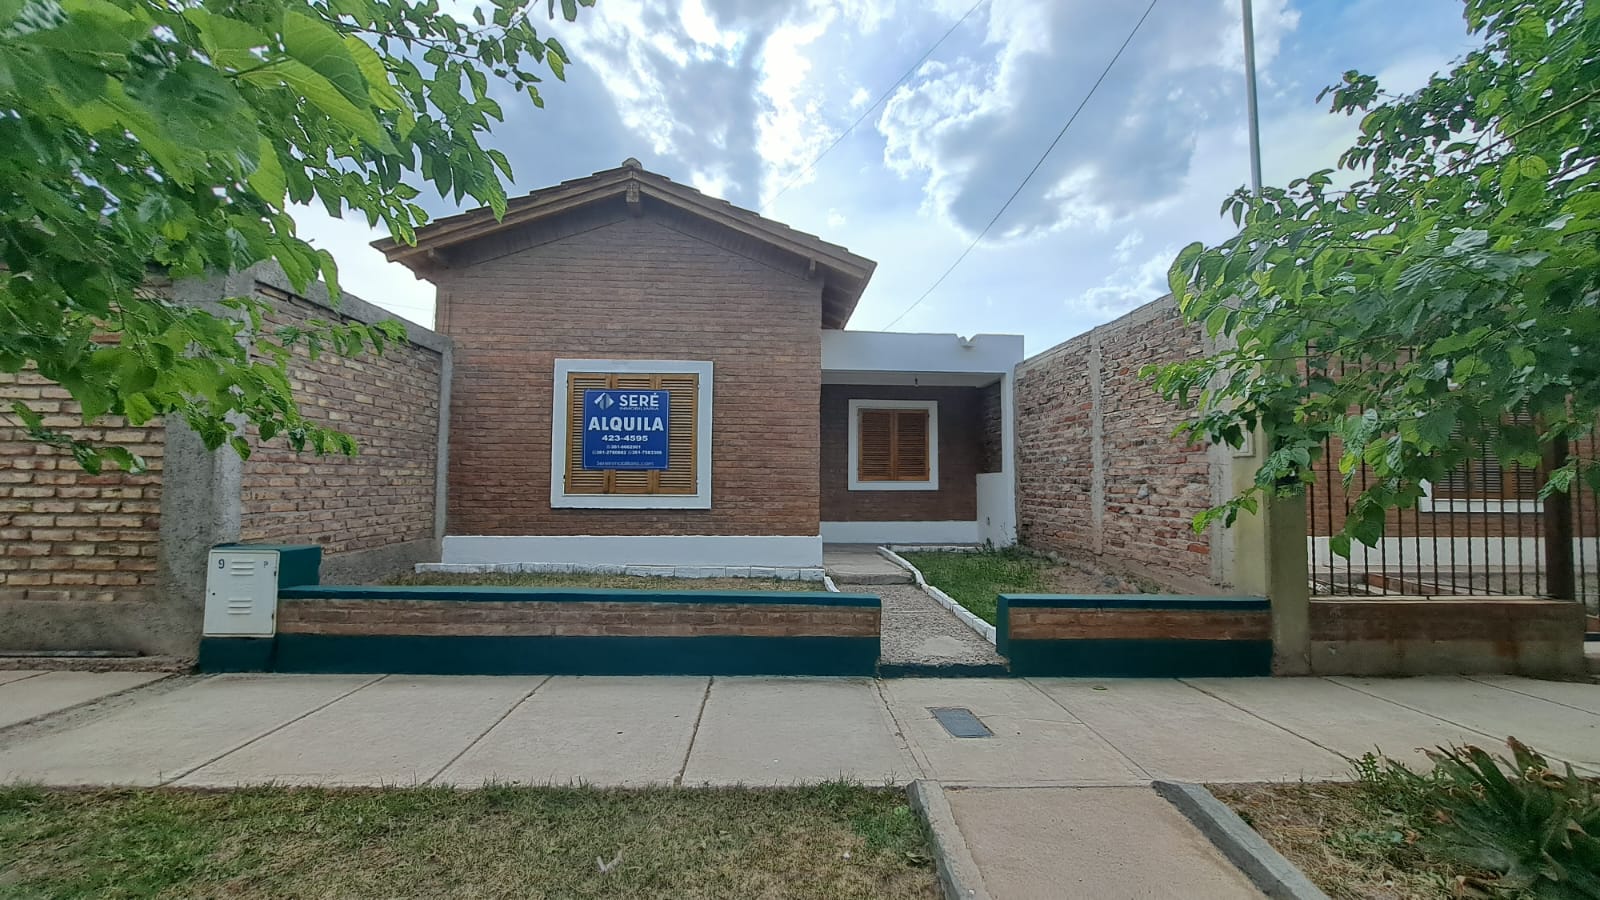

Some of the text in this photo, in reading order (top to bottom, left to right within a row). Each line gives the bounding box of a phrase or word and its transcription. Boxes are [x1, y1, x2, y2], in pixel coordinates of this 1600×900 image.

[619, 392, 659, 407] SERÉ
[588, 416, 664, 432] ALQUILA
[601, 434, 649, 442] 423-4595
